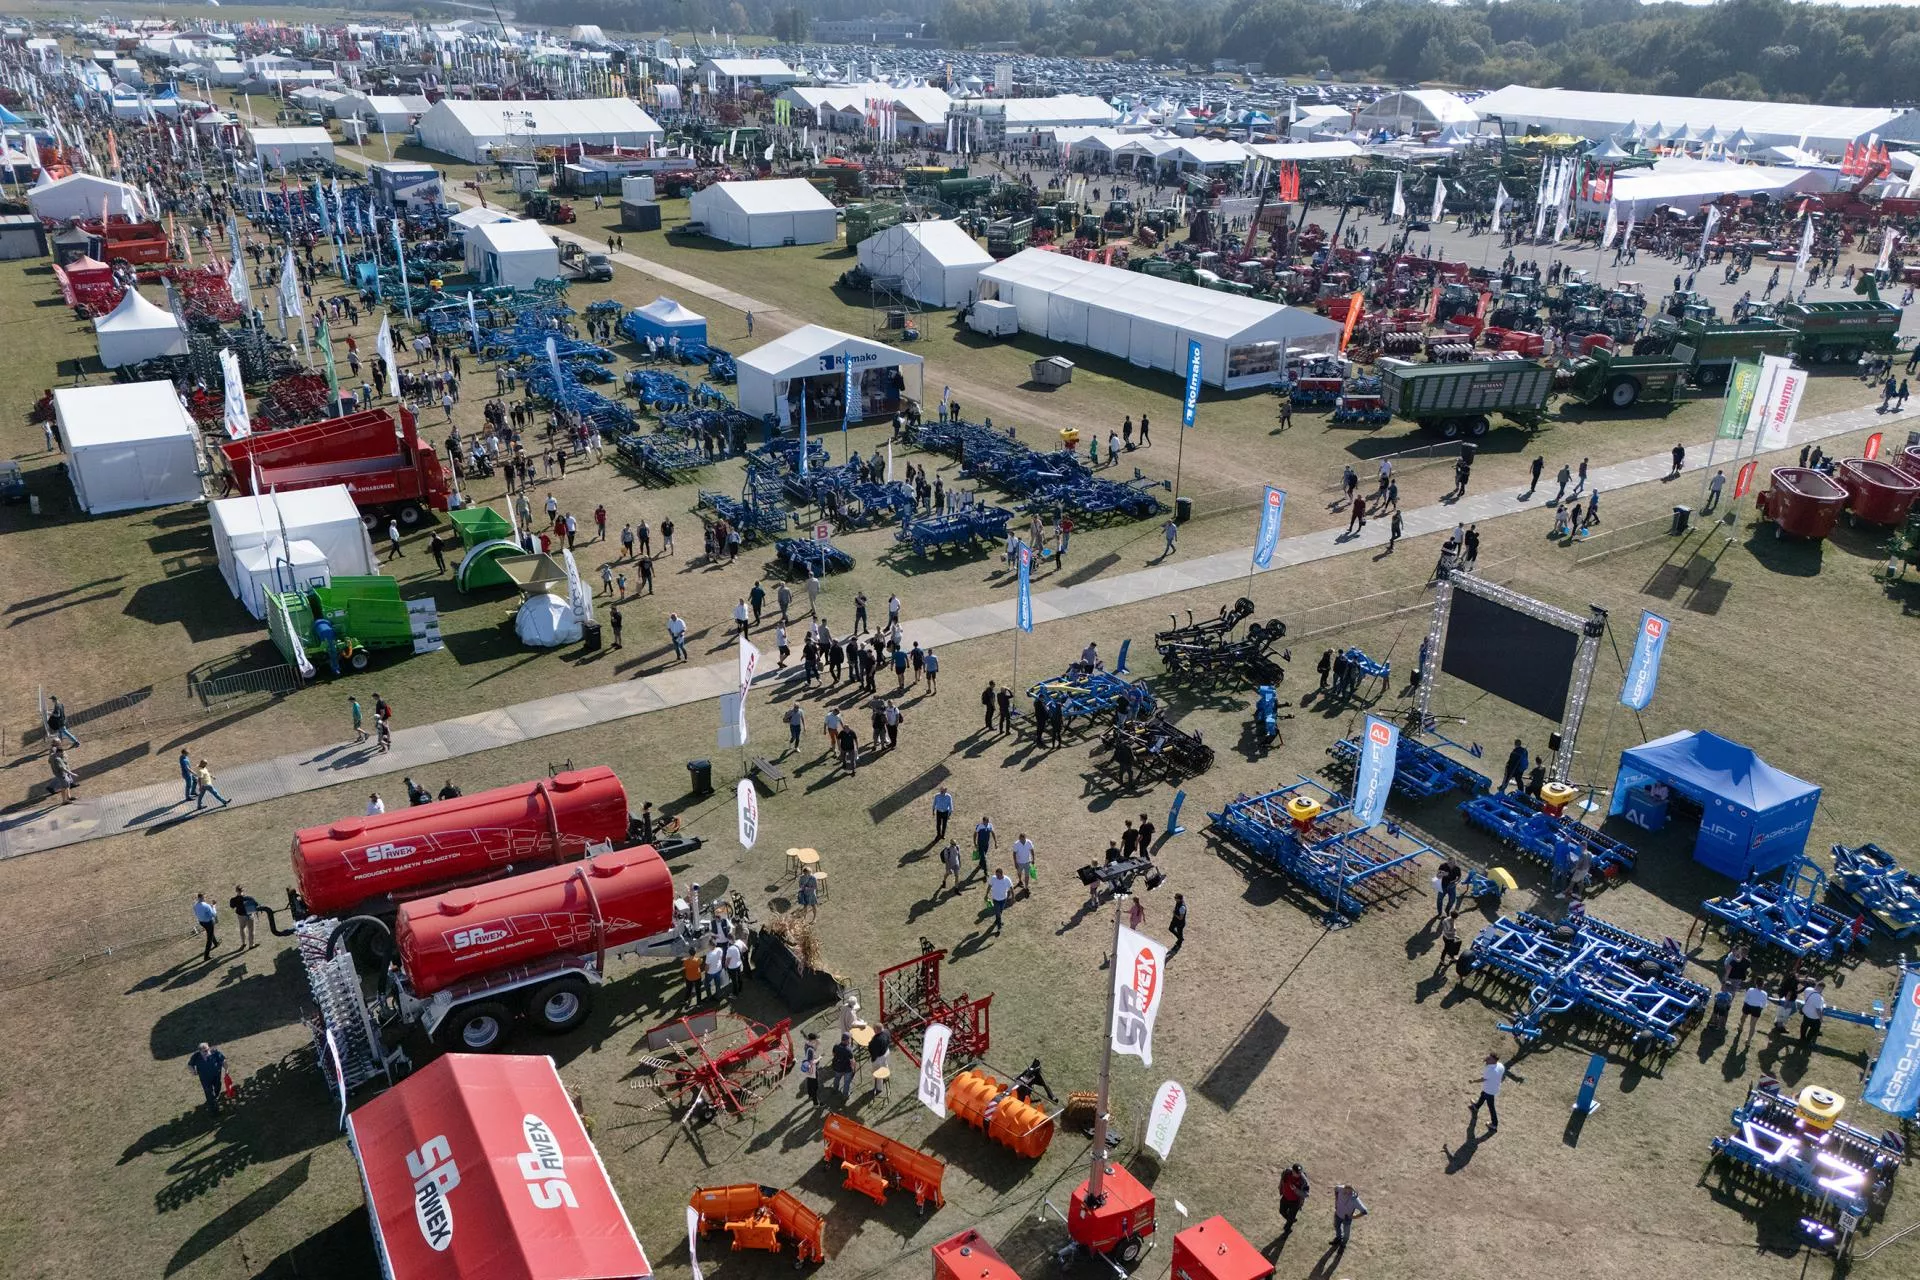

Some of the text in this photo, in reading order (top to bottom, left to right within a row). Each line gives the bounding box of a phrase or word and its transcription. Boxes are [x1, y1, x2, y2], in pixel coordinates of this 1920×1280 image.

[836, 352, 877, 365] Romako
[1187, 347, 1201, 409] Rolmako
[1775, 376, 1795, 423] MANITOU
[817, 525, 828, 538] B
[1631, 635, 1656, 706] AGRO-LIFT
[1362, 743, 1381, 821] AGRO-LIFT
[1625, 809, 1650, 830] AL
[1700, 820, 1737, 840] LIFT
[354, 867, 392, 880] PRODUCENT
